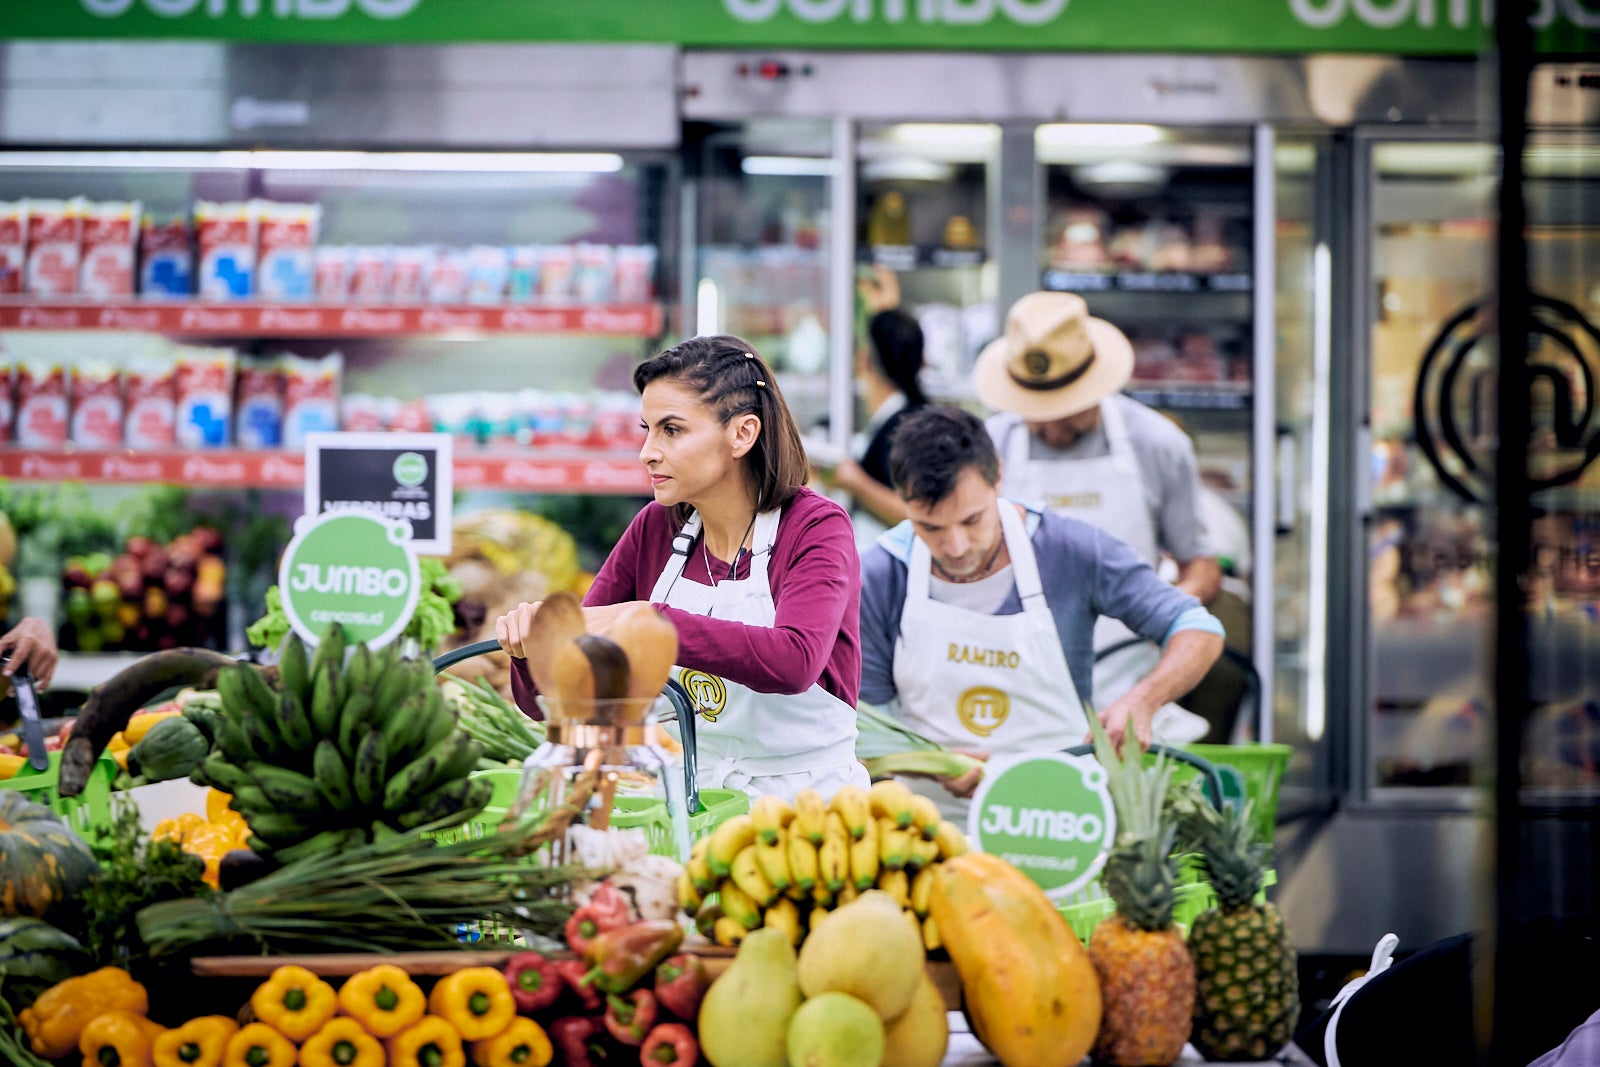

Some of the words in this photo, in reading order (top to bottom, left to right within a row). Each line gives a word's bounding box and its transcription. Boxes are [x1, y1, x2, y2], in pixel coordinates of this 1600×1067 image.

[291, 563, 408, 597] JUMBO
[947, 643, 1020, 669] RAMIRO
[982, 804, 1102, 843] JUMBO
